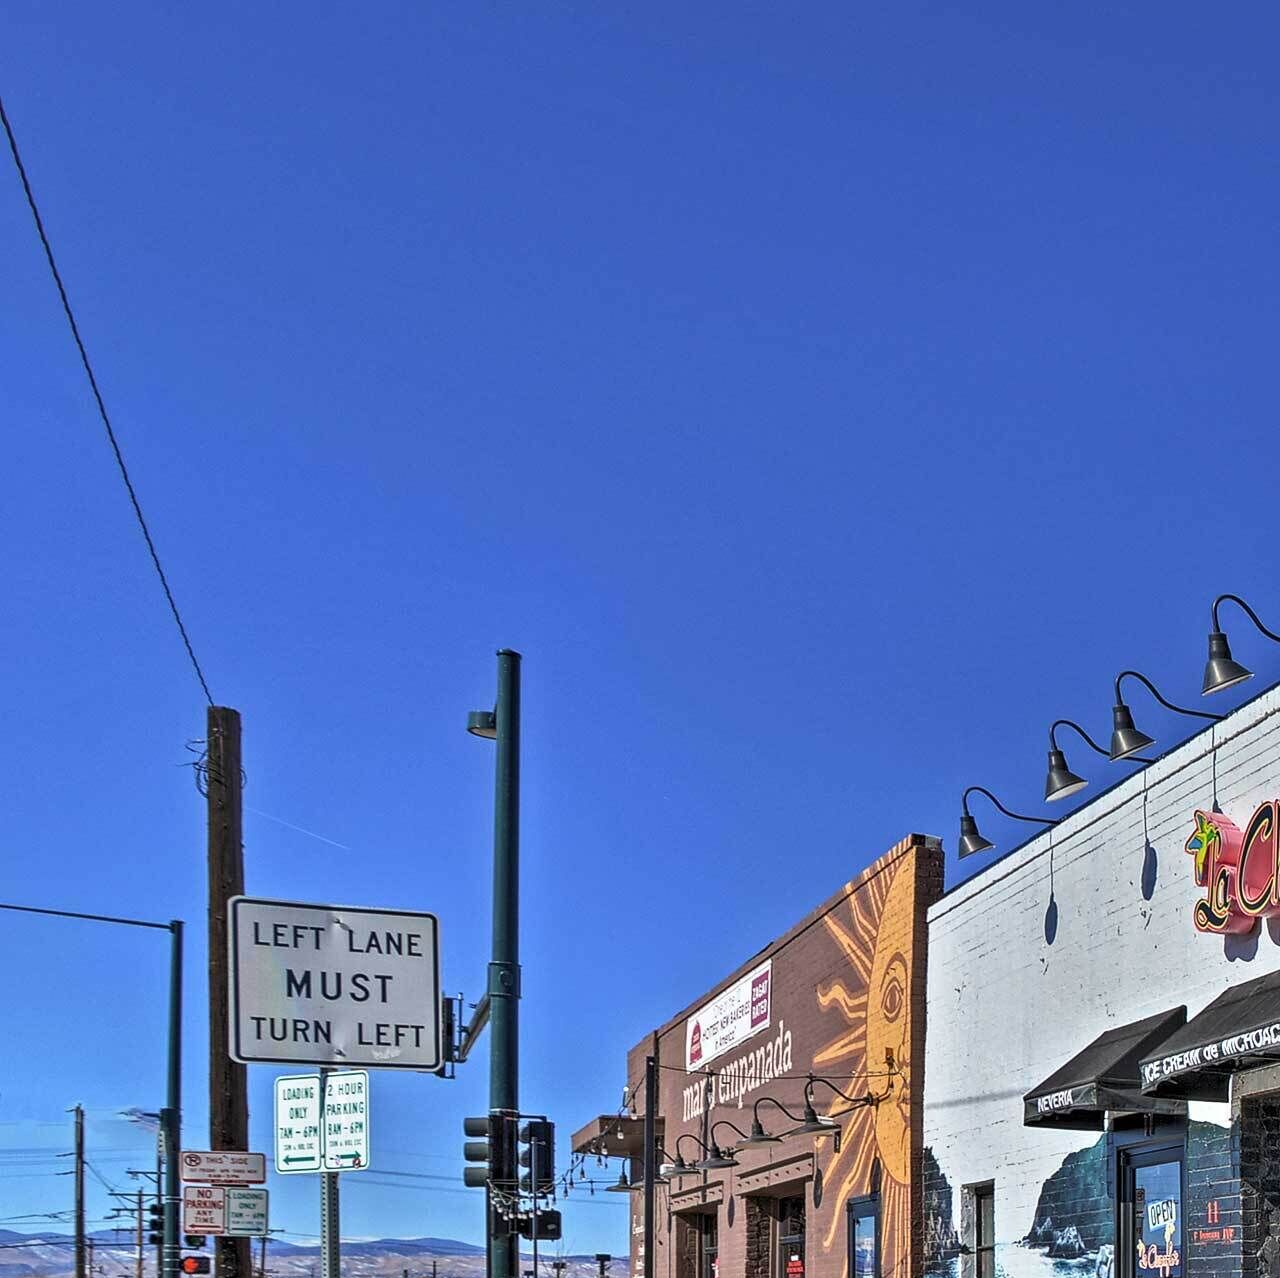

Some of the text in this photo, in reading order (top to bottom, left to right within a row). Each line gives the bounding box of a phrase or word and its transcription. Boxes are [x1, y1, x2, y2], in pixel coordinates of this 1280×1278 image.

[1194, 826, 1234, 930] La
[253, 921, 423, 957] LEFT LANE
[286, 968, 393, 1003] MUST
[250, 1016, 425, 1048] TURN LEFT
[682, 1020, 793, 1122] mara empanada
[1144, 1060, 1161, 1083] ICE
[1163, 1048, 1201, 1075] CREAM
[1203, 1043, 1219, 1061] de
[282, 1086, 315, 1101] LOADING
[327, 1081, 364, 1097] 2 HOUR
[326, 1101, 364, 1116] PARKING
[1037, 1089, 1073, 1113] NEVERIA
[288, 1106, 308, 1120] ONLY
[196, 1189, 213, 1199] NO
[186, 1199, 225, 1210] PARKING
[196, 1209, 213, 1217] ANY
[1149, 1200, 1174, 1227] OPEN
[194, 1216, 215, 1224] TIME
